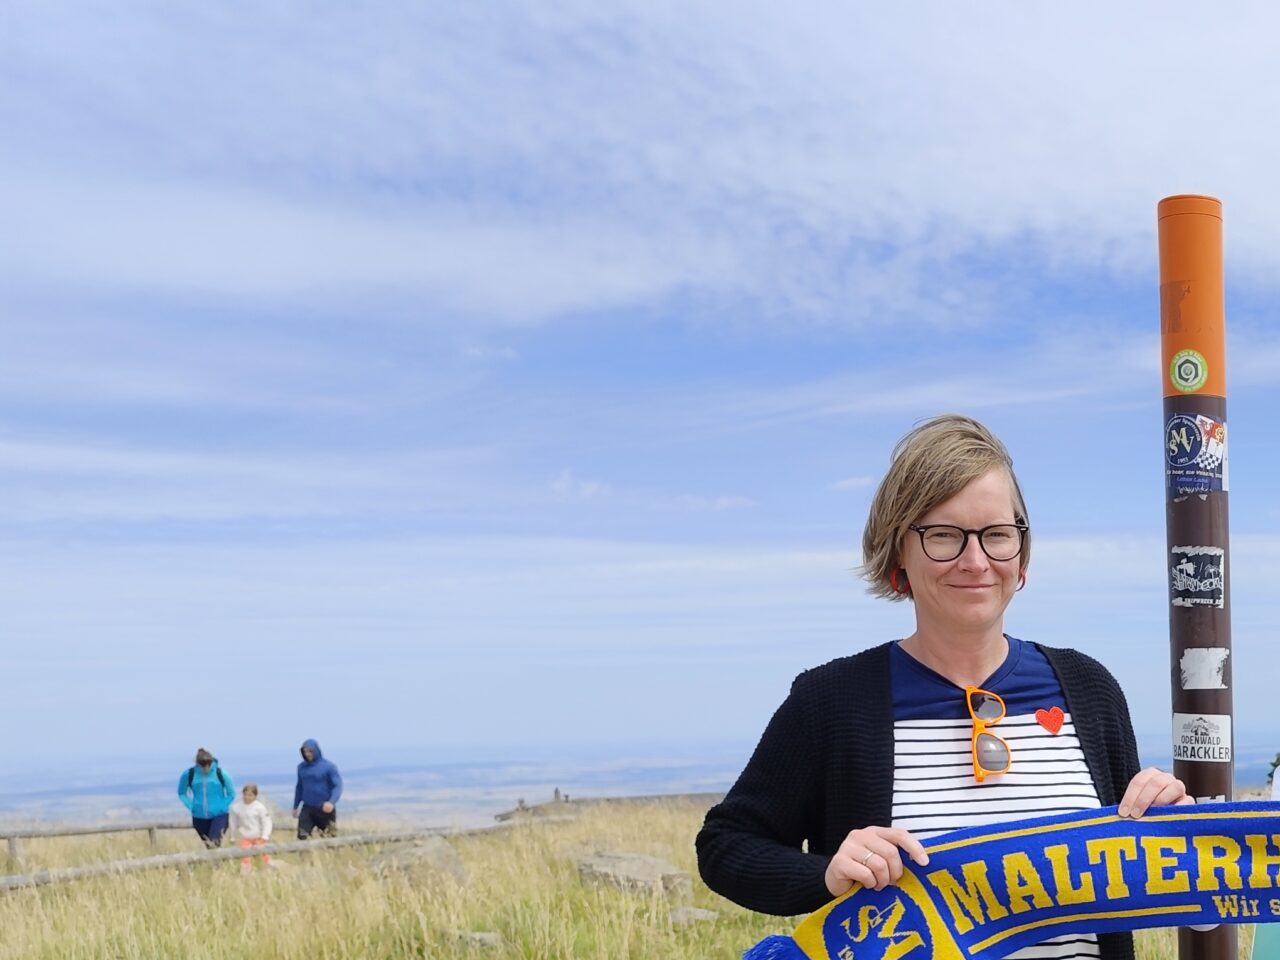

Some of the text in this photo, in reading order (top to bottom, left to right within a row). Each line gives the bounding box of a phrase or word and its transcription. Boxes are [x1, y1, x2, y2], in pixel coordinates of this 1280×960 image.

[1181, 735, 1221, 745] ODENWALD
[1173, 745, 1230, 760] BARACKLER
[1212, 894, 1260, 918] Wir
